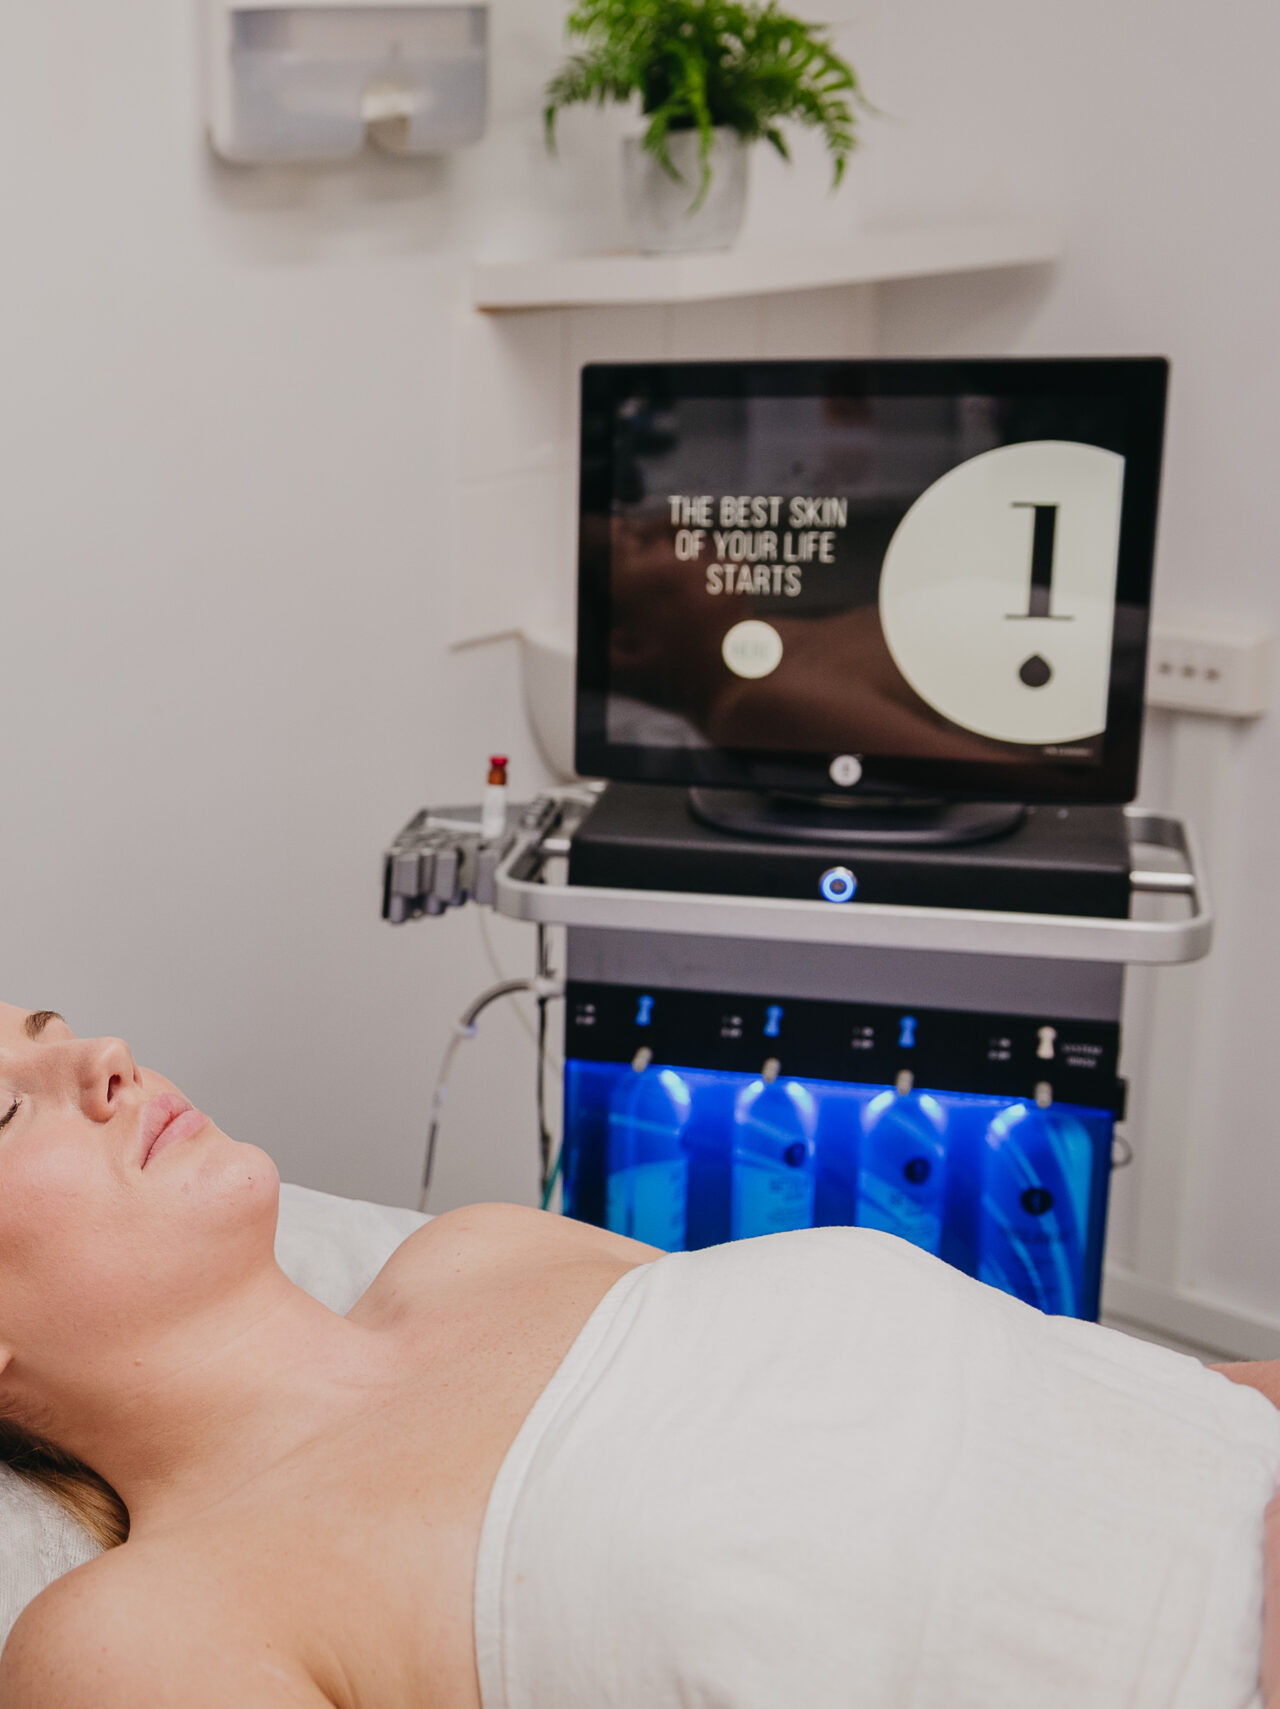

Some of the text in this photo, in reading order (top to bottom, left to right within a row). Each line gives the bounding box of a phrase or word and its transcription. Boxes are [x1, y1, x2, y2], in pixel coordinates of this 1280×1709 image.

[668, 495, 848, 529] THE BEST SKIN
[674, 529, 836, 563] OF YOUR LIFE
[706, 563, 802, 597] STARTS
